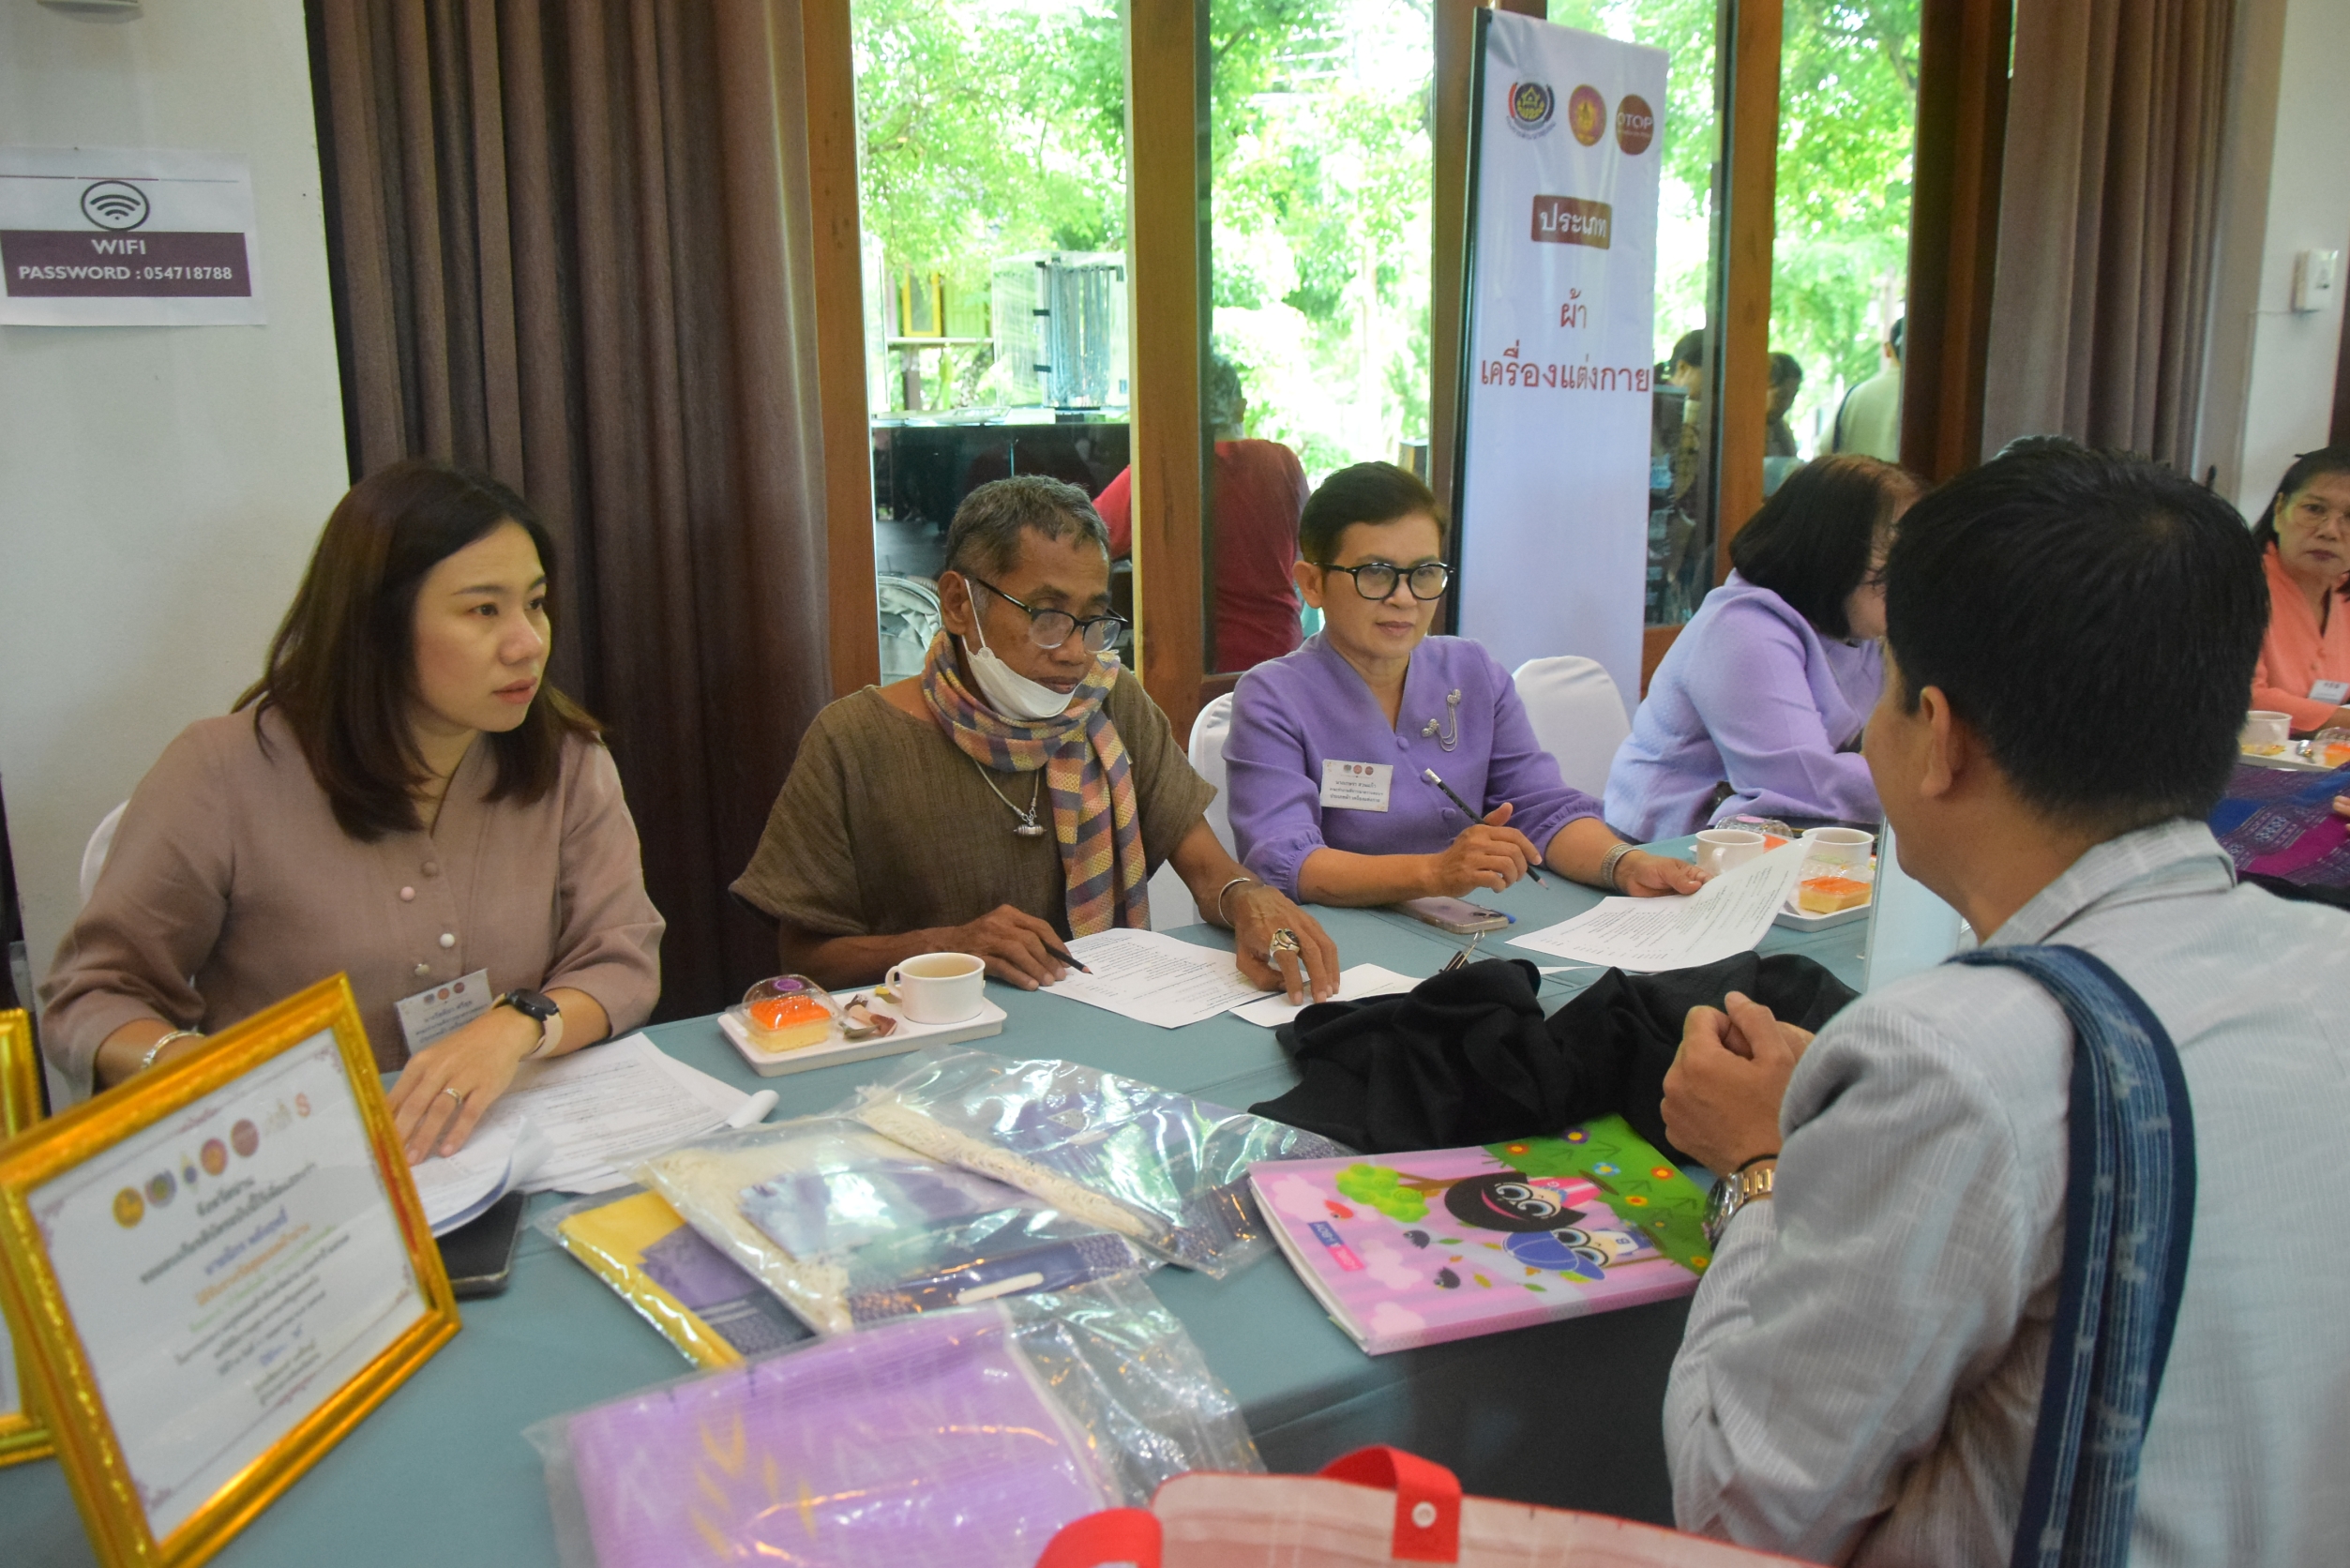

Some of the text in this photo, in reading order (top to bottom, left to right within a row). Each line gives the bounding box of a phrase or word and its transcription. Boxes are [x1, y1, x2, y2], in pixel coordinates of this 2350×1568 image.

[1617, 112, 1653, 129] OTOP
[1540, 202, 1607, 237] ประเภท
[91, 239, 147, 255] WIFI
[19, 265, 131, 279] PASSWORD
[143, 266, 233, 279] 054718788
[1559, 287, 1588, 328] ผ้า
[1481, 339, 1650, 392] เครื่องแต่งกาย
